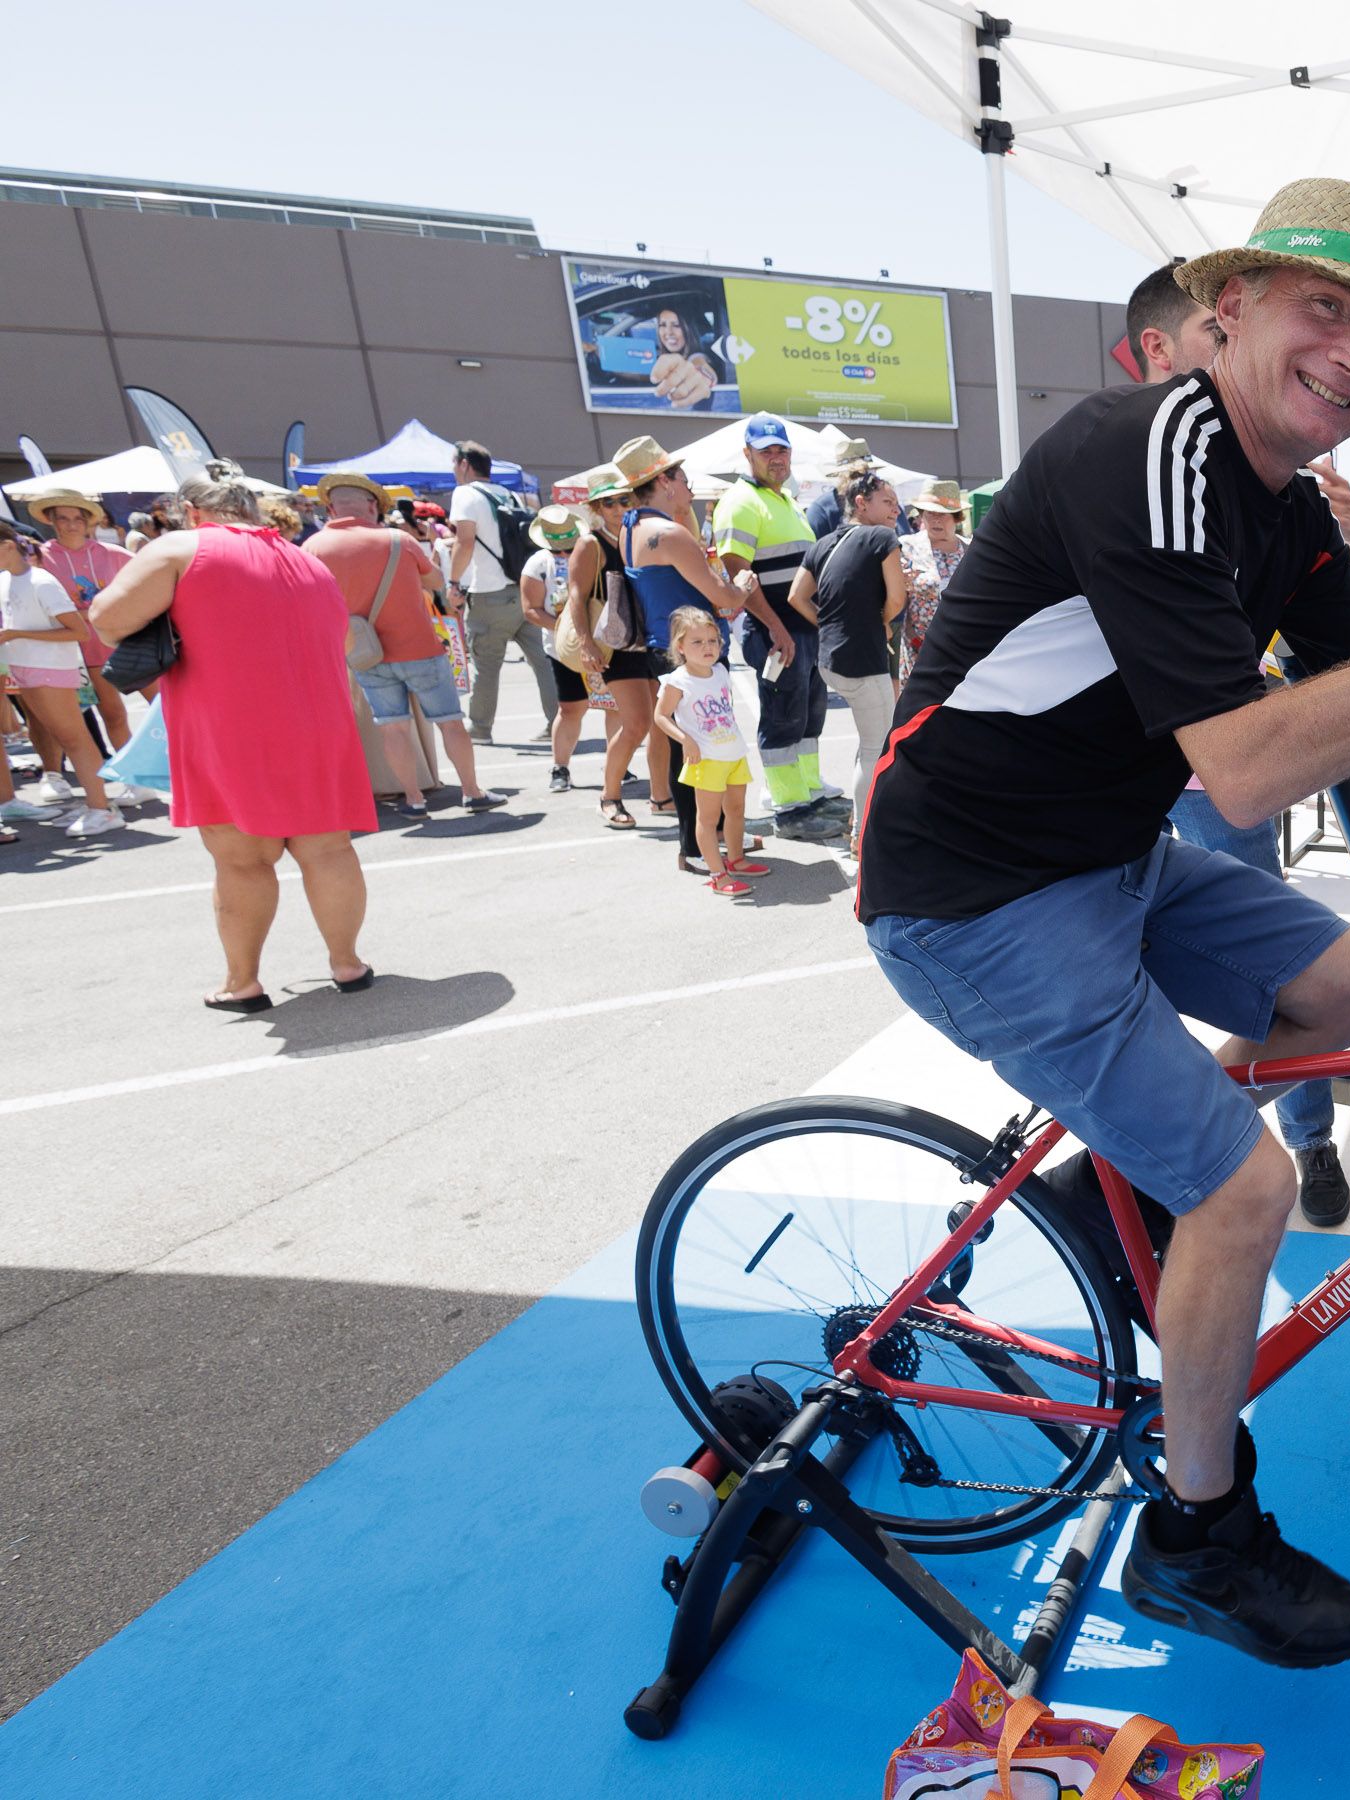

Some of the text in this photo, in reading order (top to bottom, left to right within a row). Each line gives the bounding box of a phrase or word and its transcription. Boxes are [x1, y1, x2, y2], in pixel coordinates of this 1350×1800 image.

[784, 295, 894, 348] -8%
[782, 346, 900, 366] todos los días
[1310, 1299, 1338, 1325] LA
